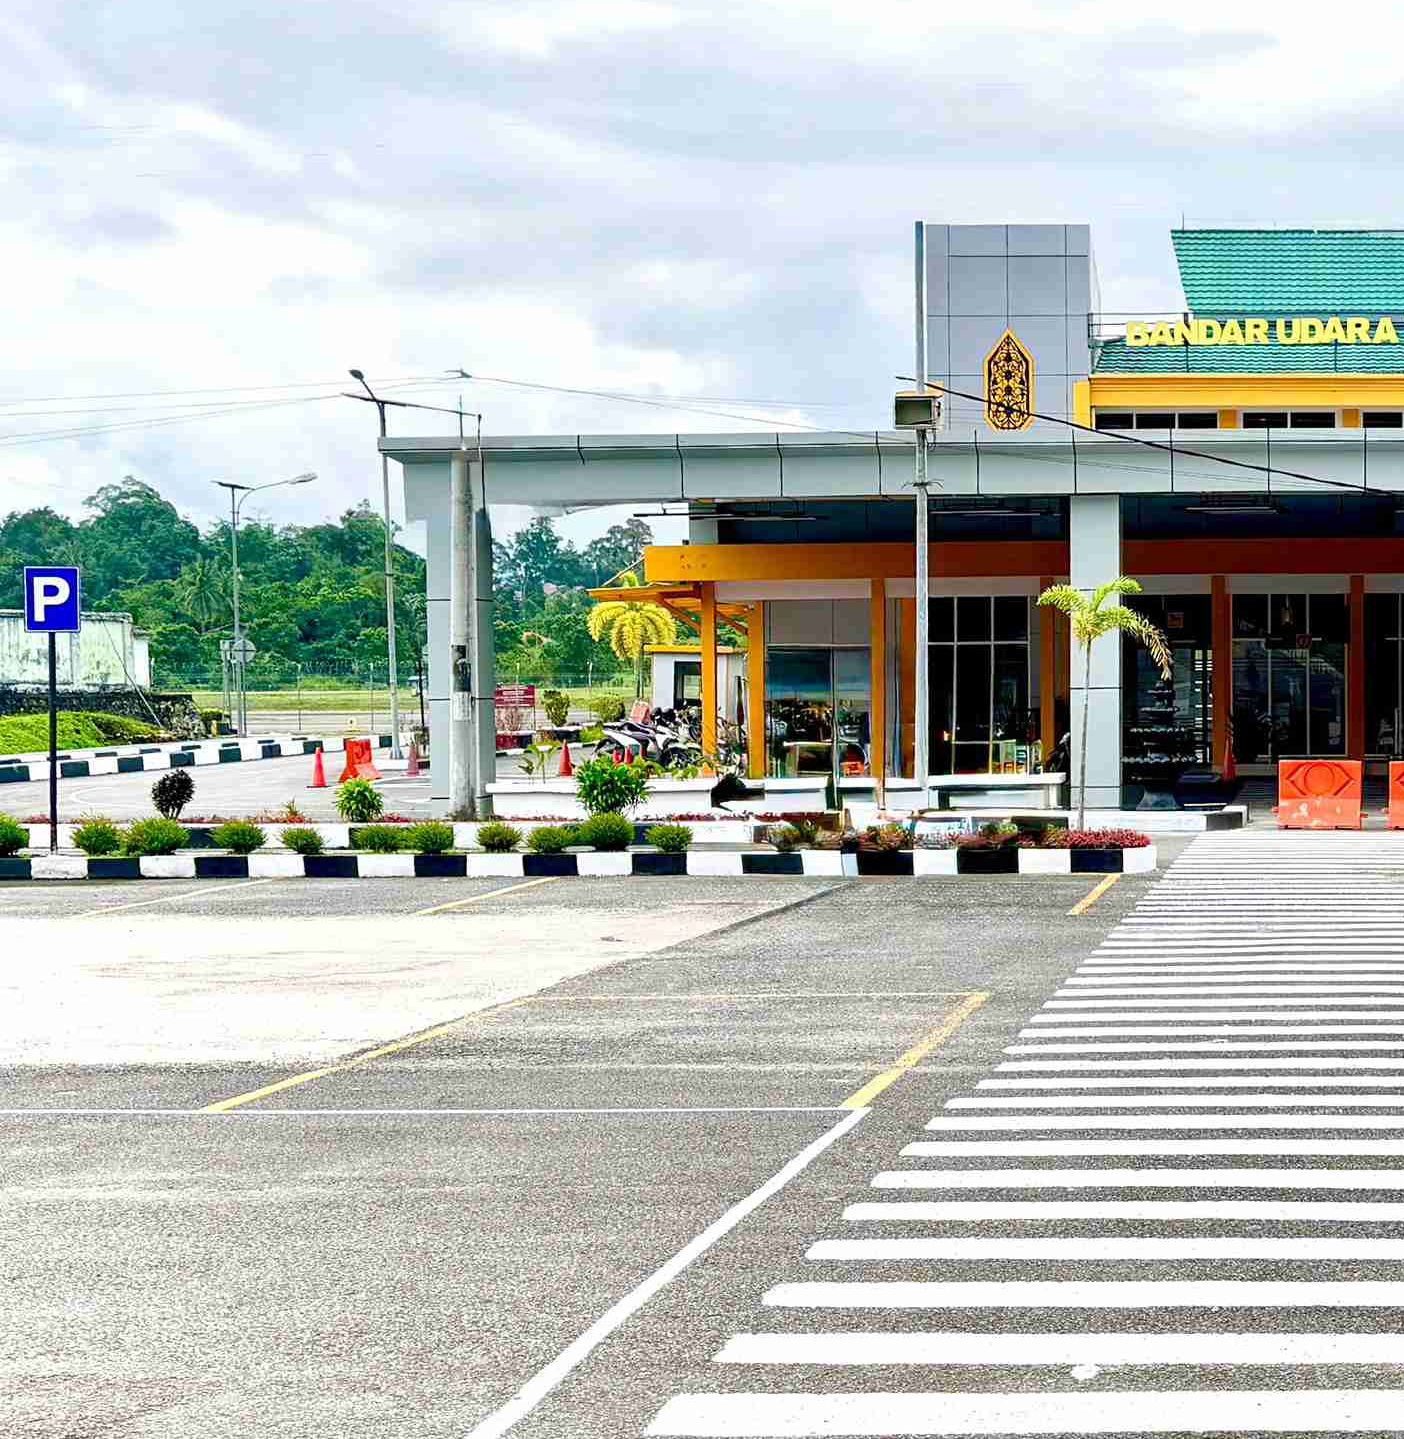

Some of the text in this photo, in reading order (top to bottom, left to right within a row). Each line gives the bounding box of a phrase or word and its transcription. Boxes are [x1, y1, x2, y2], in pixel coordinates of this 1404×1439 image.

[1126, 319, 1268, 346] BANDAR
[1275, 316, 1399, 344] UDARA
[33, 576, 70, 622] P
